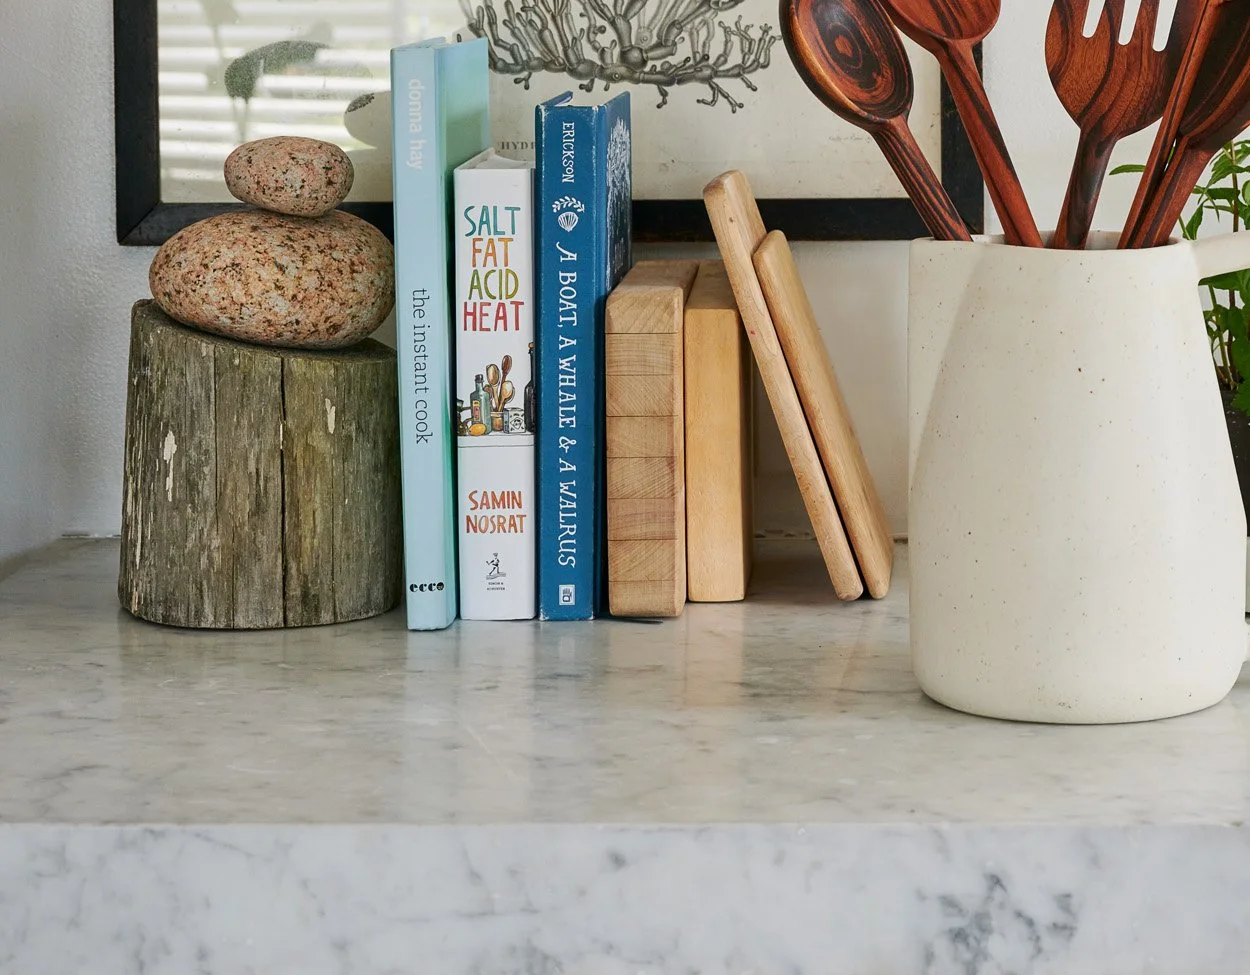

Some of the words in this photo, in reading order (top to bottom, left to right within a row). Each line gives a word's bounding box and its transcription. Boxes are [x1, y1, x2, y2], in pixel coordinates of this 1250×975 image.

[407, 78, 422, 133] donna
[407, 139, 427, 171] hay
[562, 121, 575, 183] ERICKSON
[463, 205, 521, 237] SALT
[471, 237, 514, 268] FAT
[556, 241, 577, 263] A
[468, 269, 519, 301] ACID
[557, 271, 577, 328] BOAT,
[412, 288, 431, 319] the
[463, 300, 525, 332] HEAT
[558, 335, 577, 350] A
[413, 324, 431, 394] instant
[558, 355, 577, 429] WHALE
[414, 400, 433, 444] cook
[558, 436, 577, 453] &
[559, 459, 577, 472] A
[467, 489, 523, 511] SAMIN
[465, 514, 526, 534] NOSRAT
[557, 480, 577, 569] WALRUS
[409, 581, 444, 592] ecco
